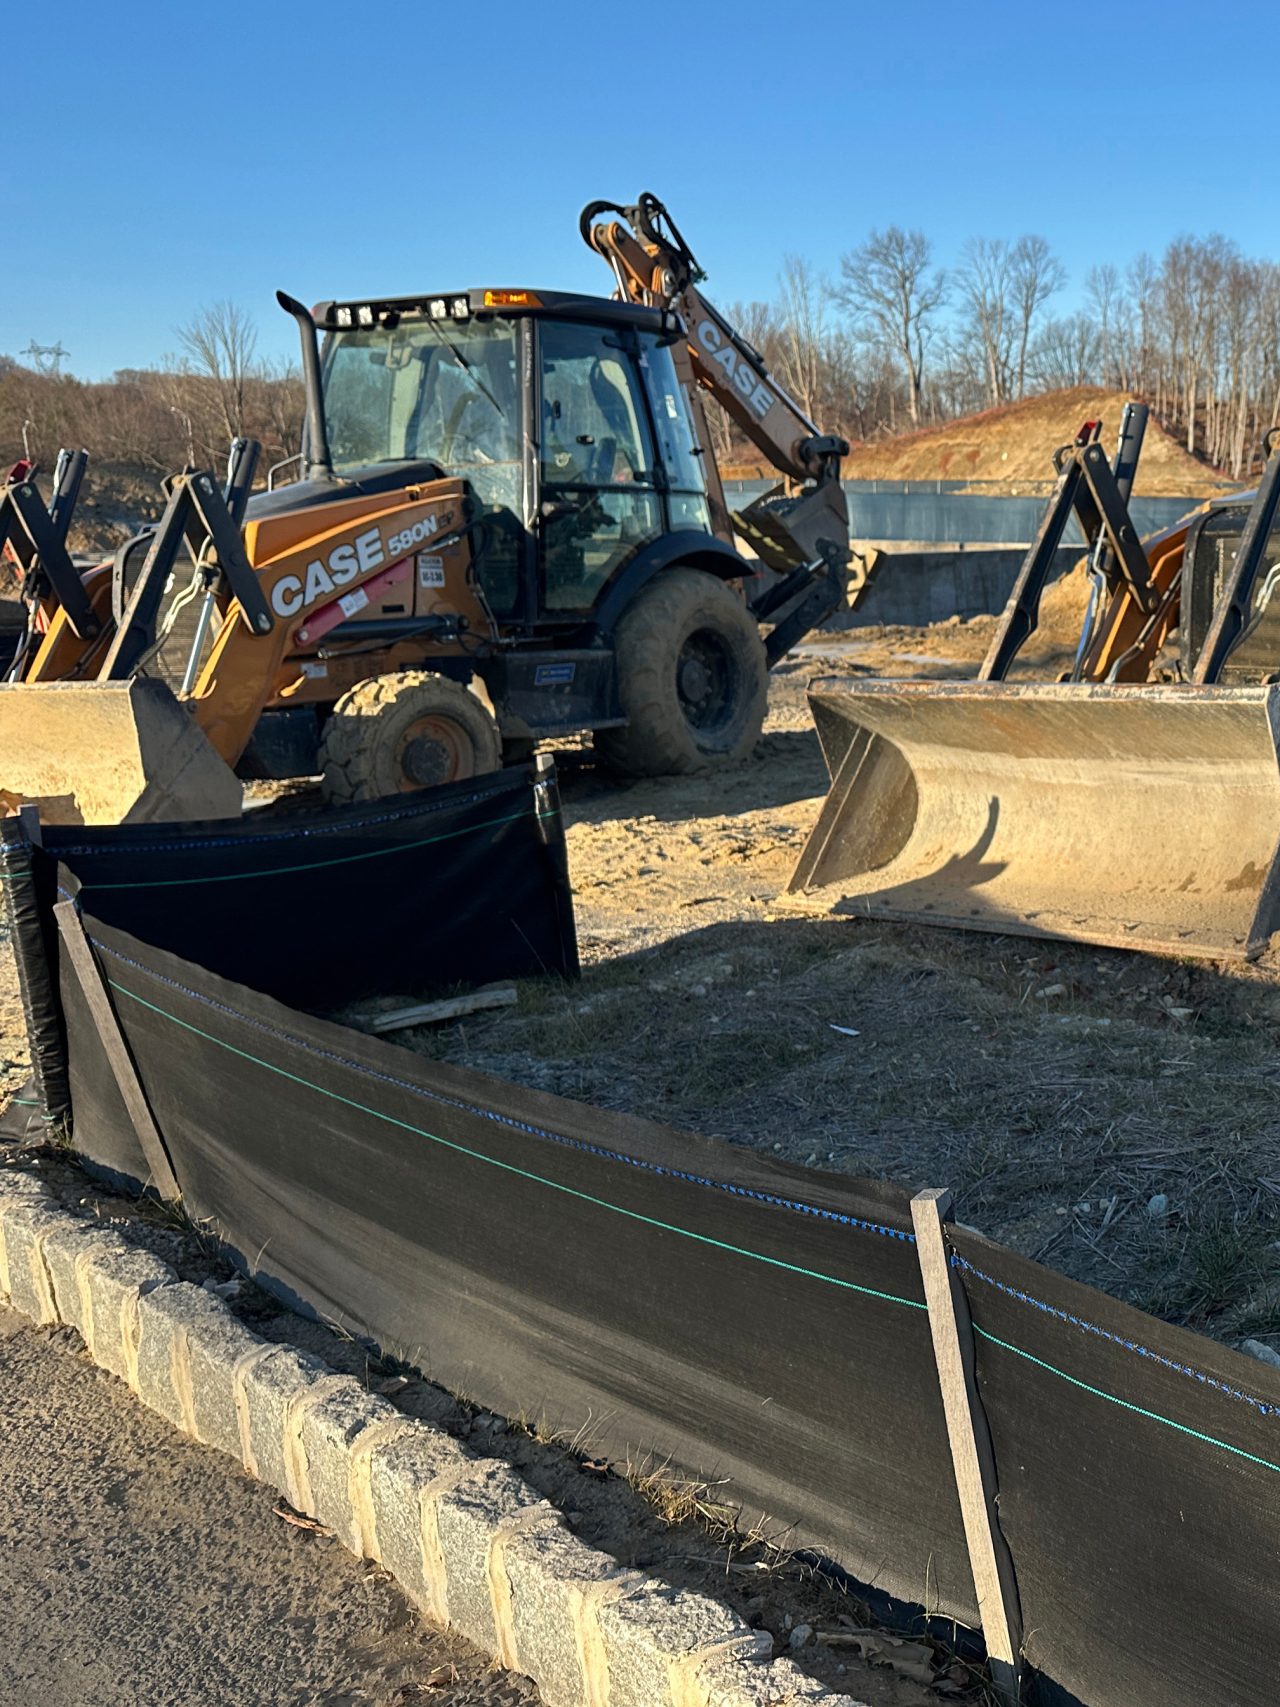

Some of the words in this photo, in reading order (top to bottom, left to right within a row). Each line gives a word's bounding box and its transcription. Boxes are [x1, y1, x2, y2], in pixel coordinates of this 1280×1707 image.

[697, 320, 775, 417] CASE
[271, 527, 385, 618] CASE
[387, 514, 438, 556] 580N
